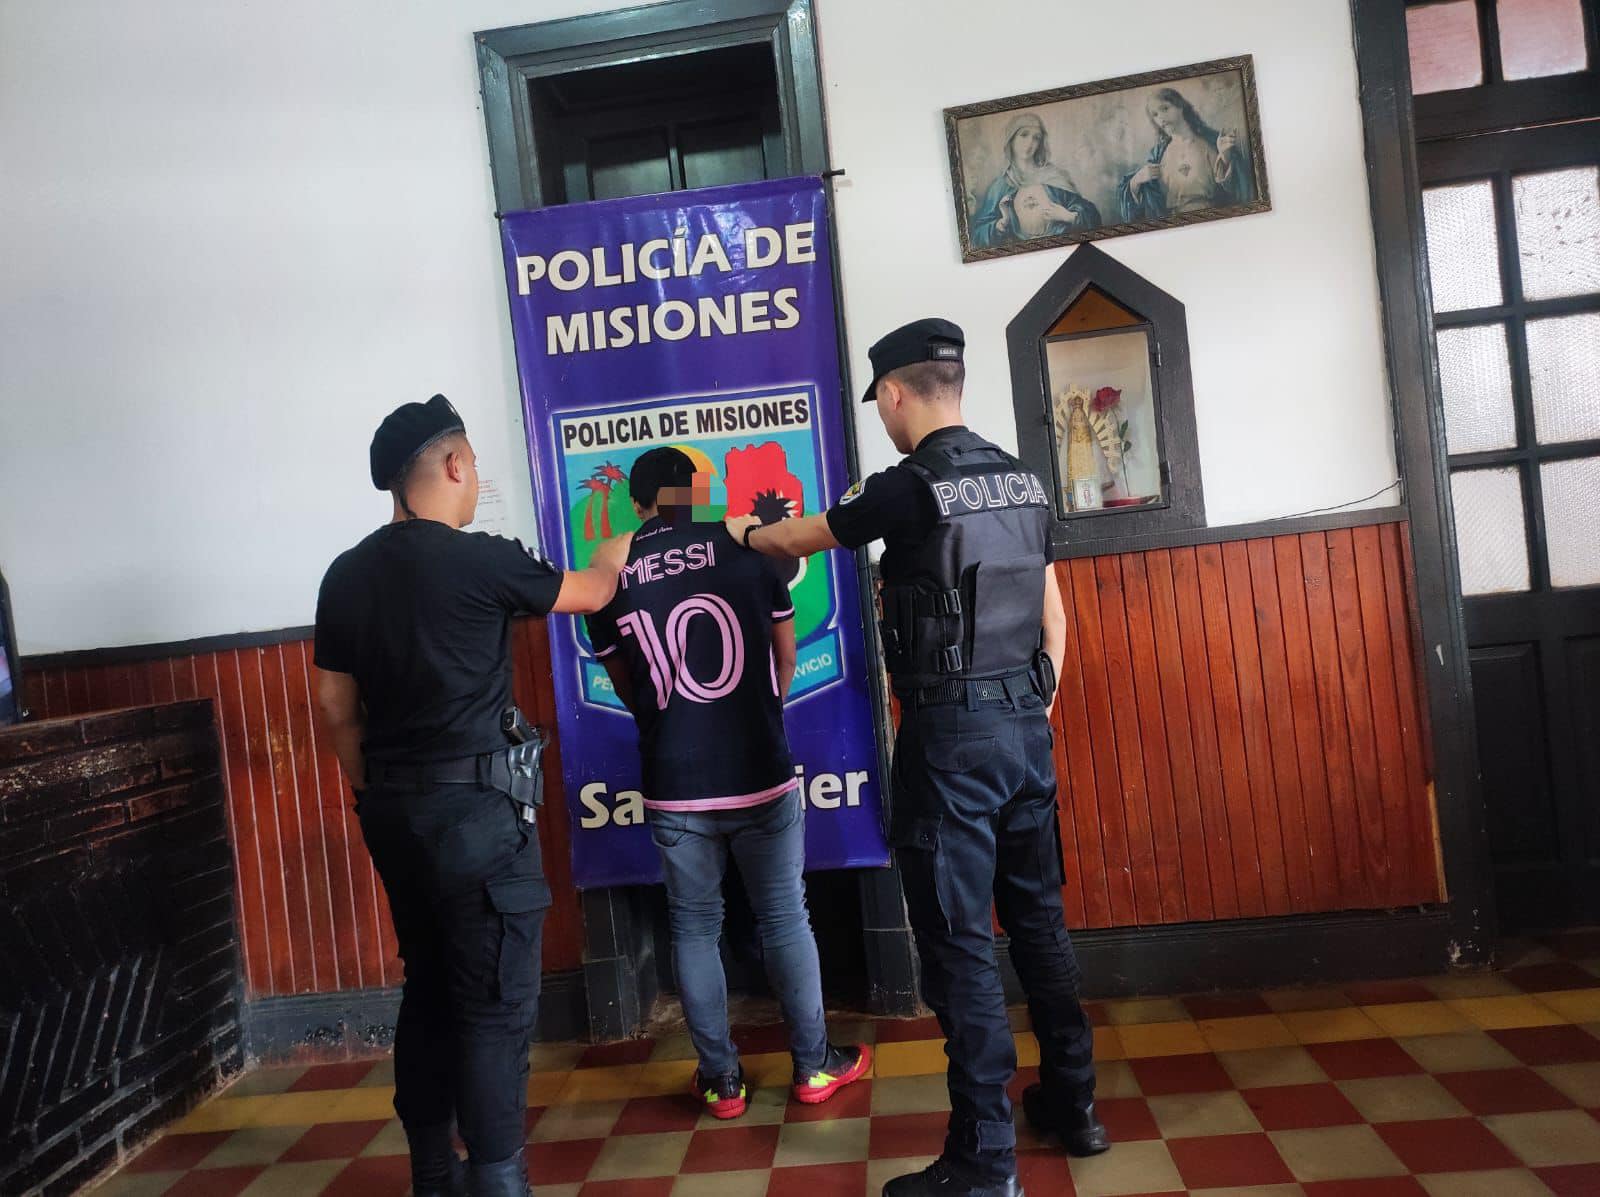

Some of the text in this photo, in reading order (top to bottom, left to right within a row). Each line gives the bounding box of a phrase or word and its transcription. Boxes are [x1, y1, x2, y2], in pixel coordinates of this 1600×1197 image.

[516, 222, 816, 296] POLICÍA DE
[546, 287, 800, 356] MISIONES
[563, 398, 810, 449] POLICIA DE MISIONES
[932, 473, 1049, 516] POLICIA
[620, 541, 716, 590] MESSI
[616, 593, 745, 711] 10
